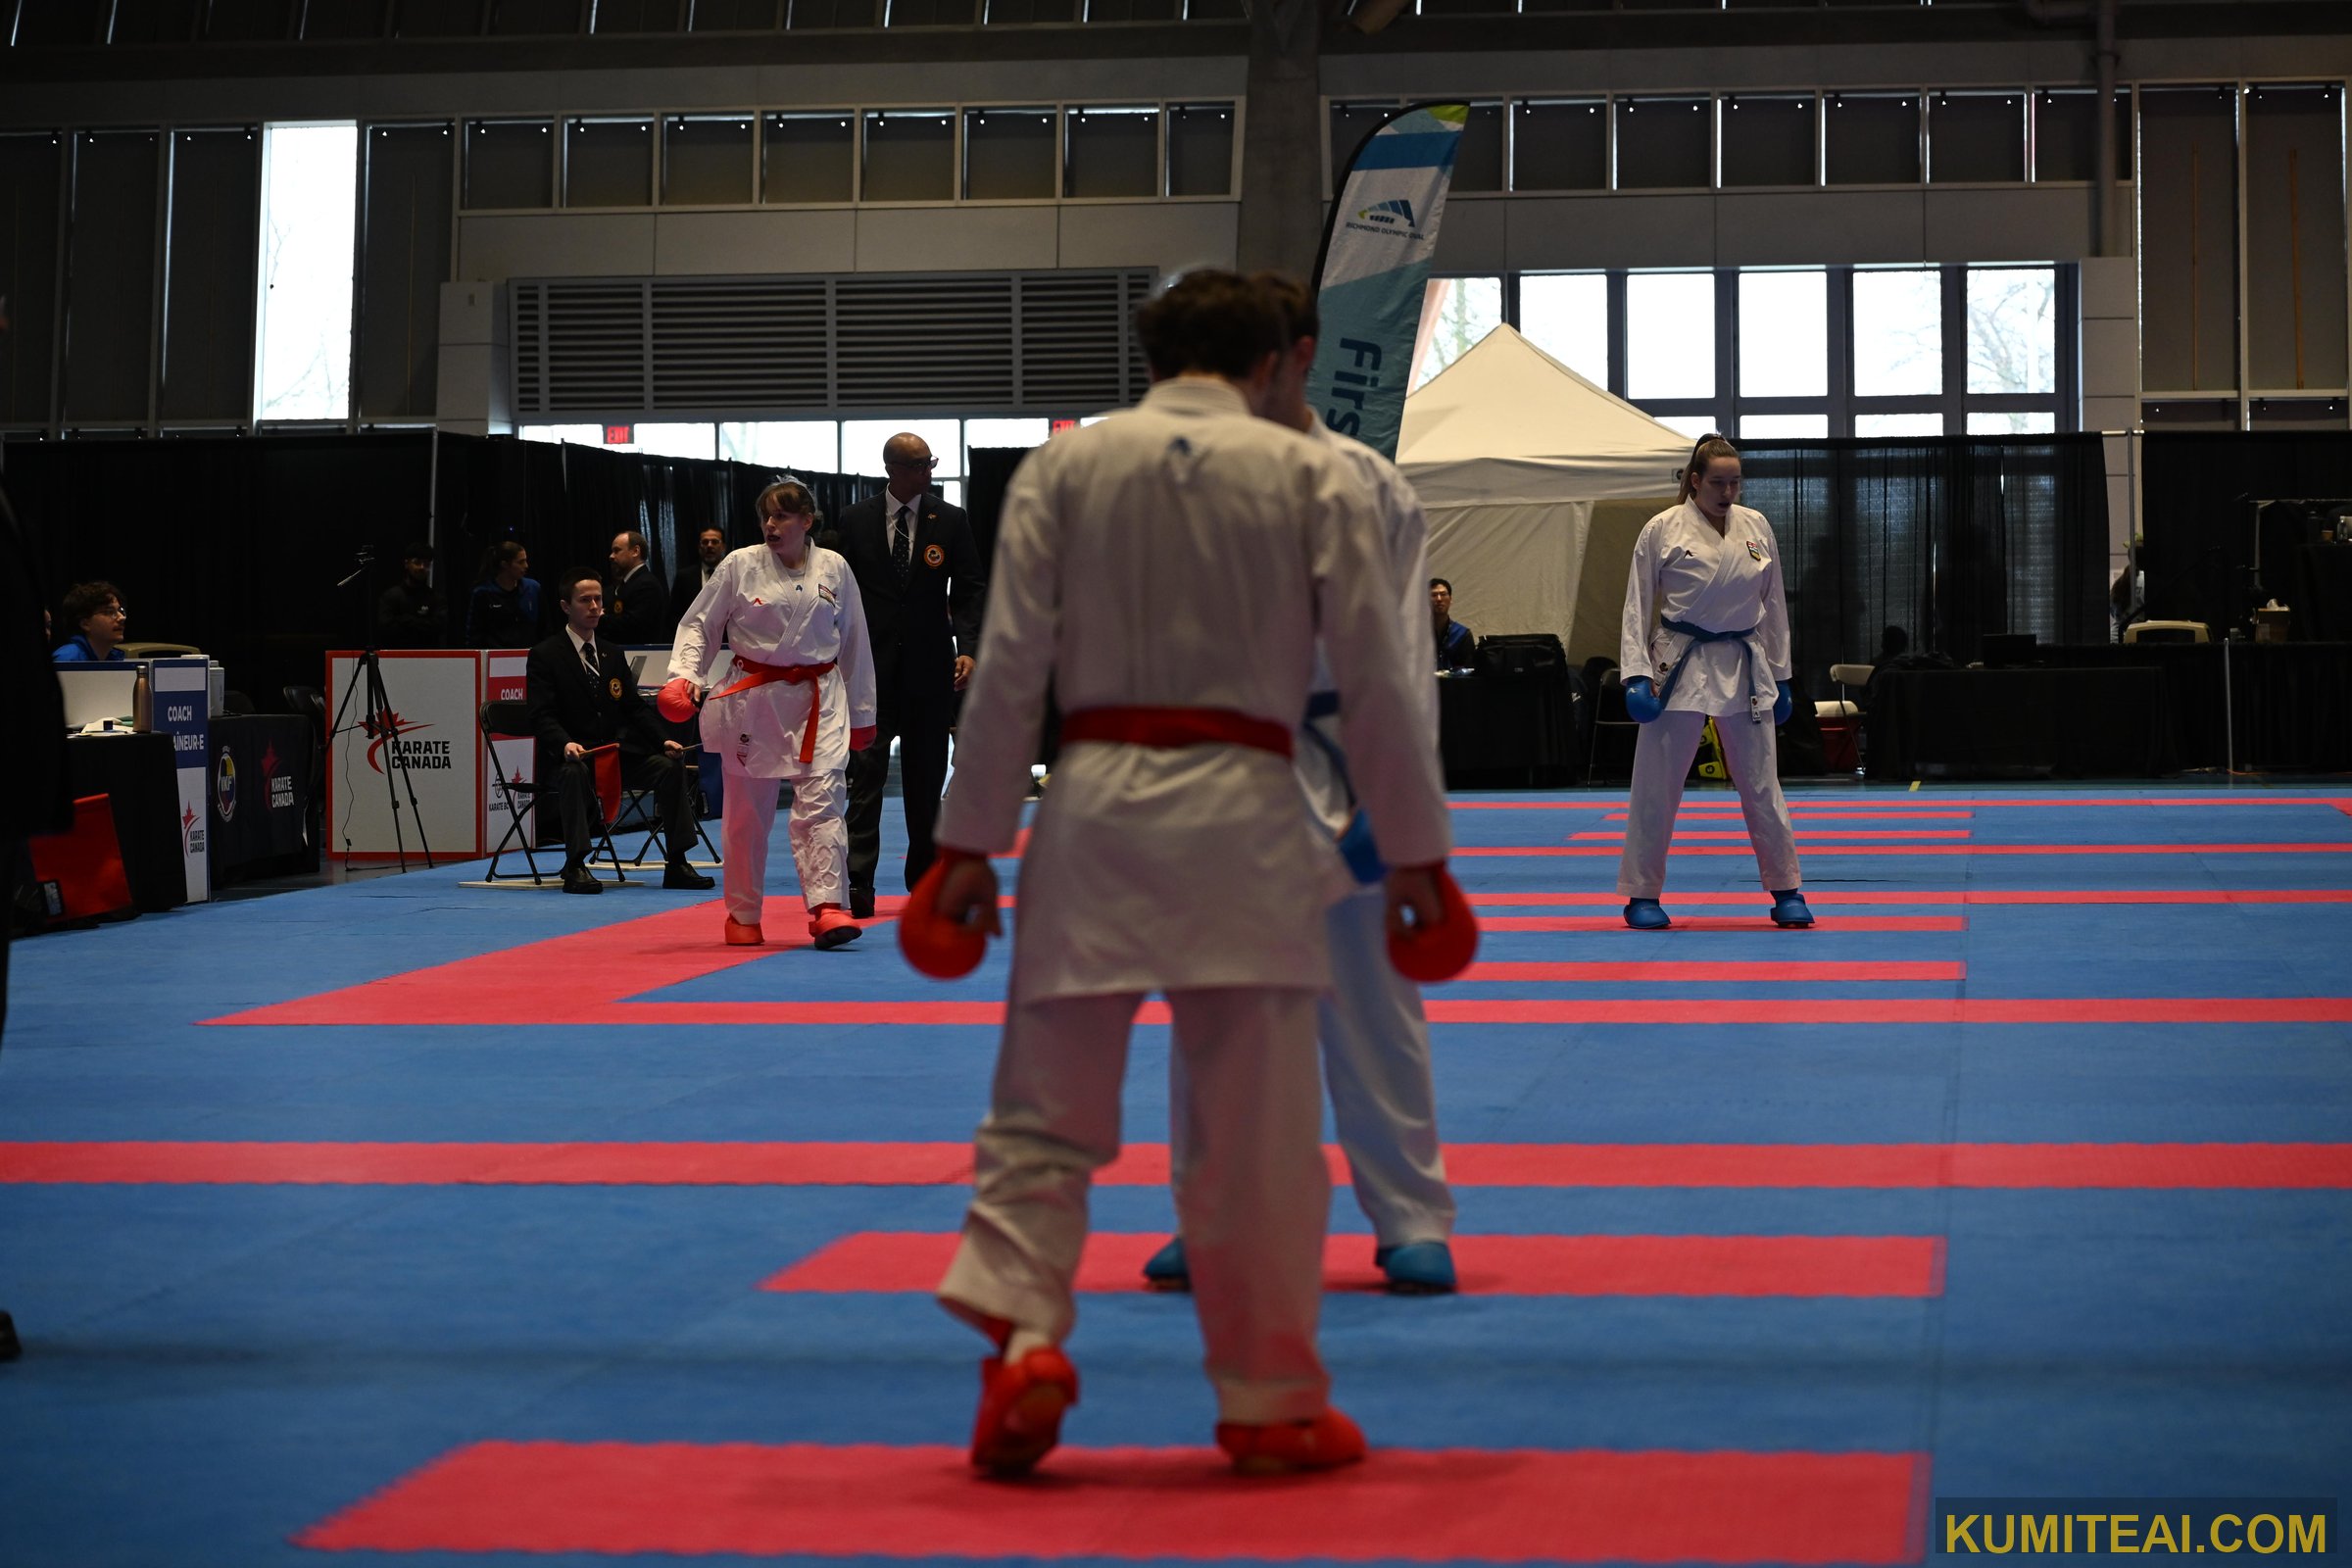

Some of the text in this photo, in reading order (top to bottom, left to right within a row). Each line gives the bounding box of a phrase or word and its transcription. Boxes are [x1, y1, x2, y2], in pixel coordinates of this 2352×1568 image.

[1346, 221, 1380, 233] RICHMOND
[1381, 227, 1408, 238] OLYMPIC
[1326, 337, 1382, 437] Firs
[607, 425, 630, 444] EXIT
[500, 688, 523, 701] COACH
[168, 706, 192, 721] COACH
[172, 731, 204, 751] AÎNEUR-E
[392, 741, 450, 755] KARATE
[392, 756, 451, 769] CANADA
[271, 776, 292, 792] KARATE
[272, 792, 294, 808] CANADA
[489, 803, 504, 811] KARATE
[190, 830, 204, 841] KARATE
[190, 842, 205, 853] CANADA
